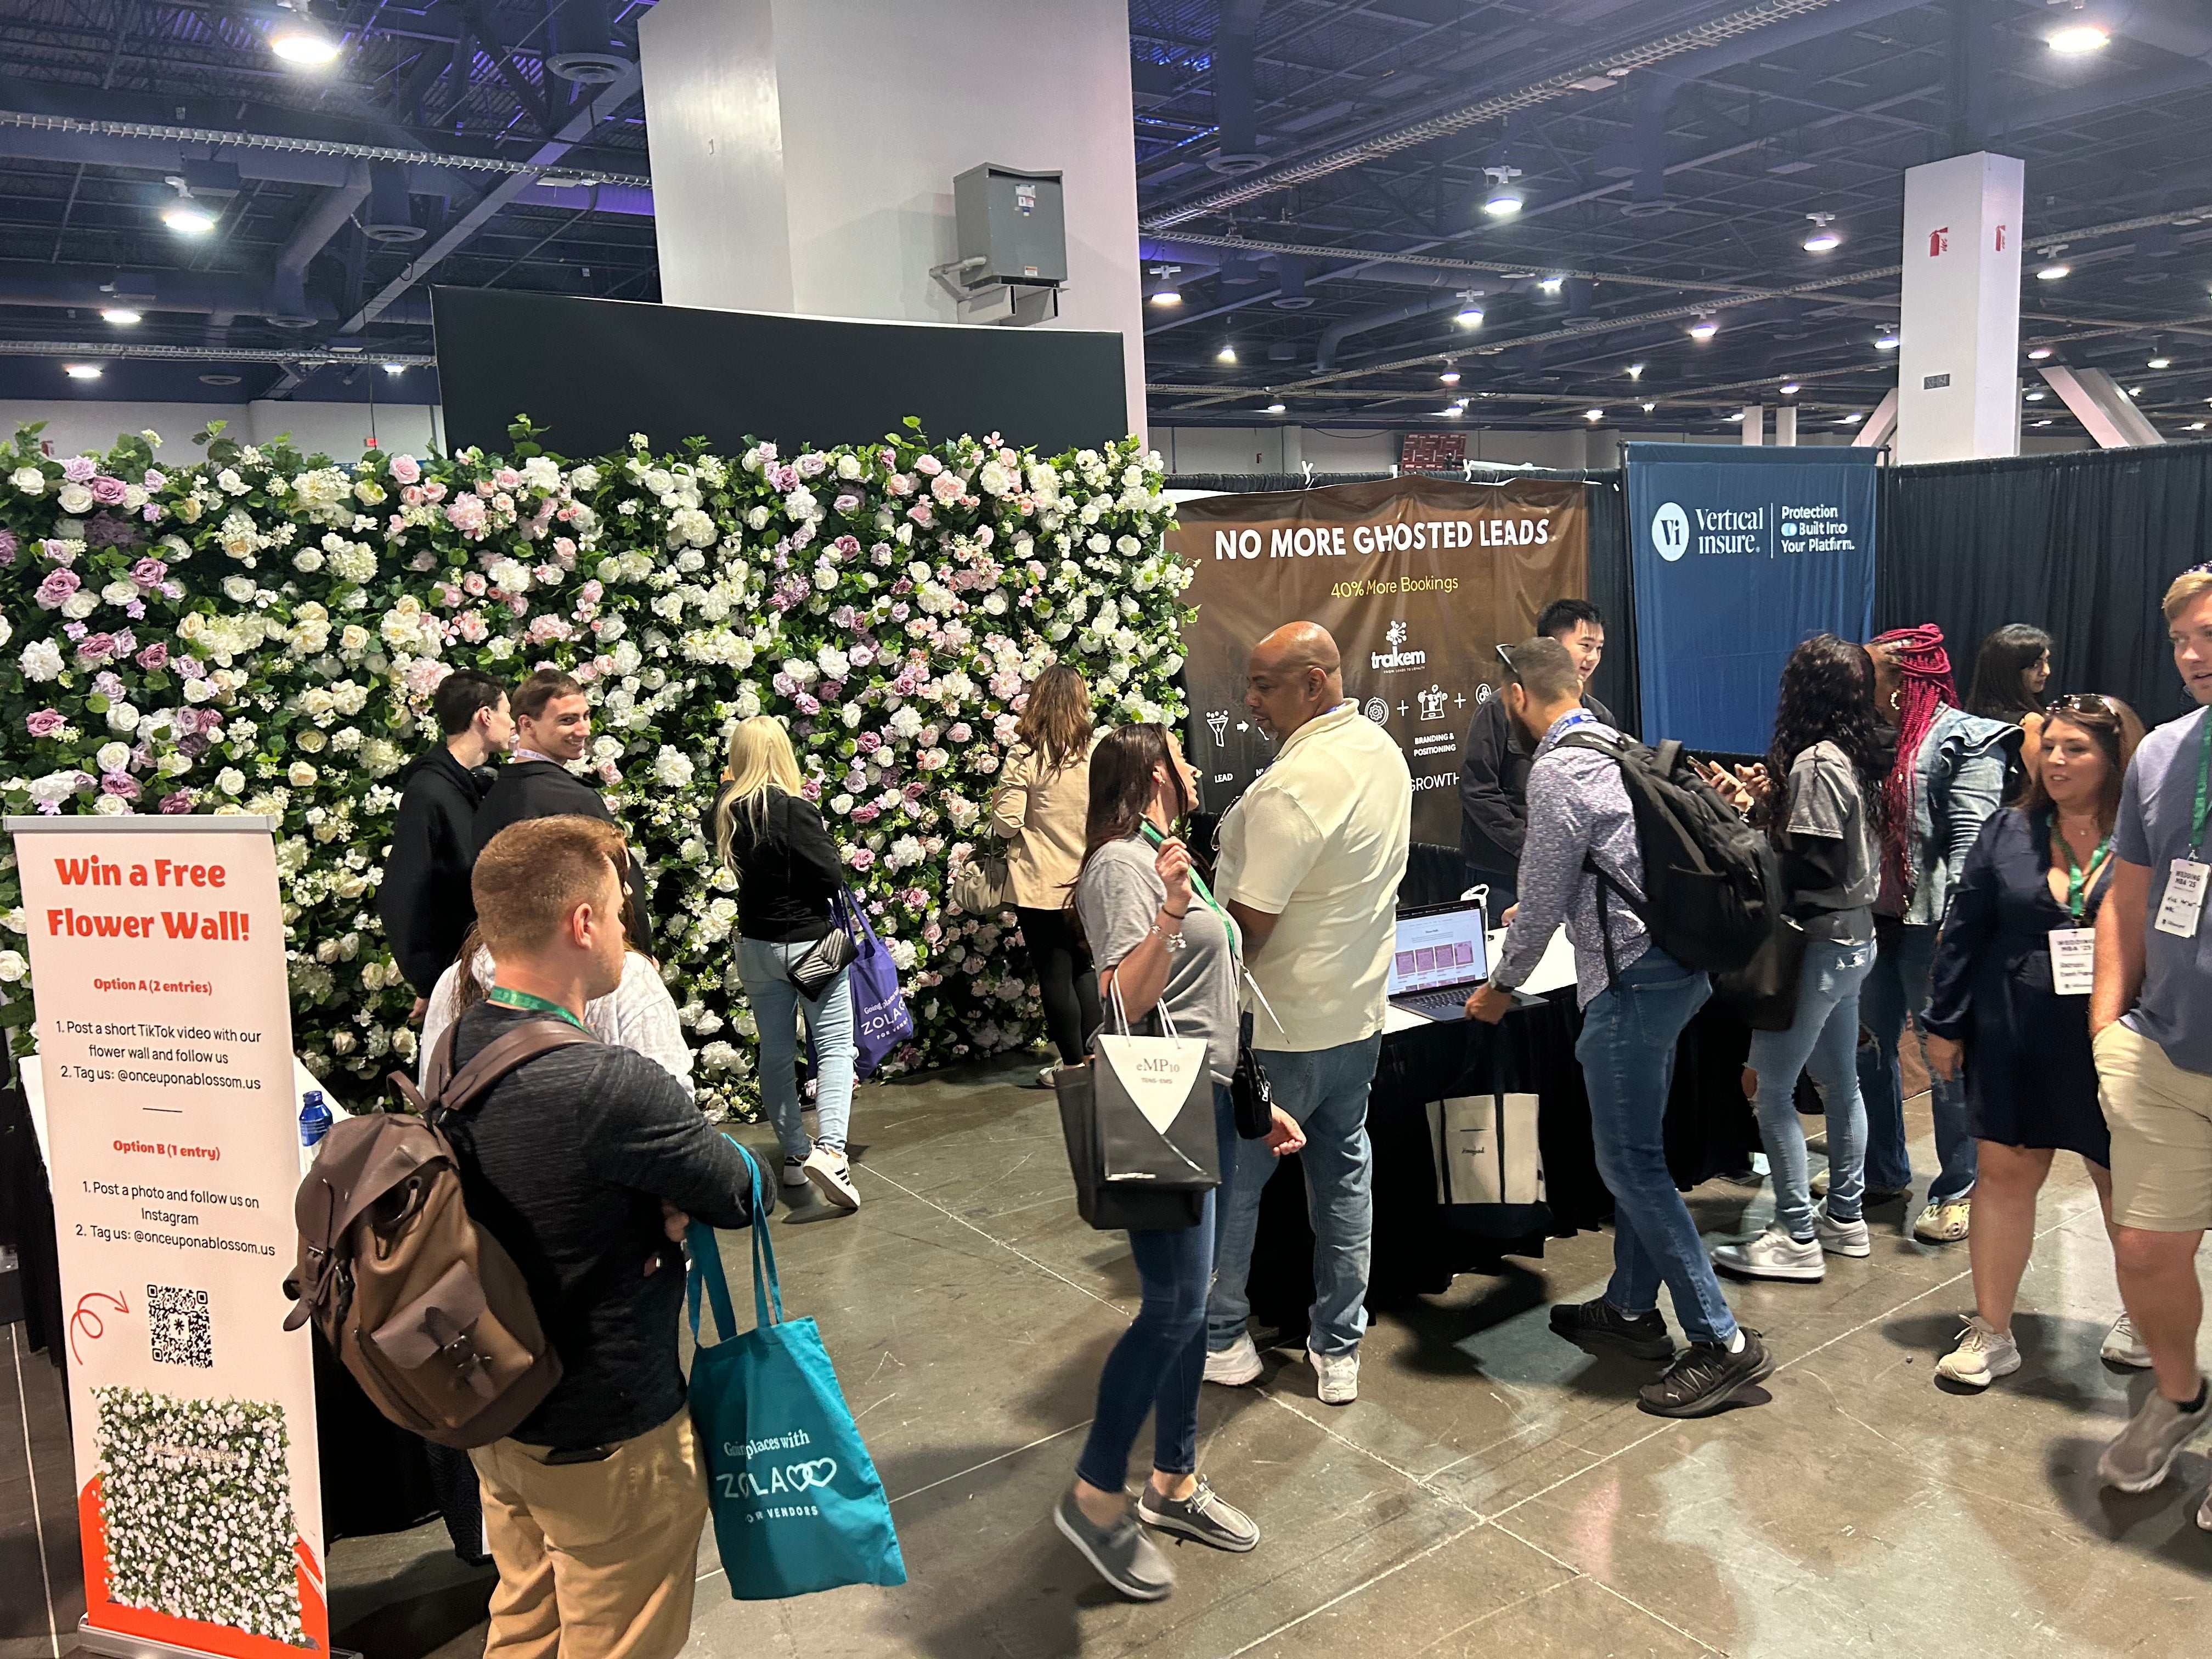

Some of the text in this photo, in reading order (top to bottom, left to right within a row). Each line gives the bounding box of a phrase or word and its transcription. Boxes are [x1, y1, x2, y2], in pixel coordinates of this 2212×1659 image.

[1695, 507, 1763, 531] Vertical
[1781, 504, 1838, 520] Protection
[1215, 518, 1550, 561] NO MORE GHOSTED LEADS
[1660, 520, 1681, 545] Vi
[1798, 521, 1826, 536] Built
[1781, 540, 1805, 554] Your
[1330, 575, 1459, 599] 40% More Bookings
[1371, 646, 1425, 669] trakem
[1413, 743, 1457, 757] POSITIONING
[1414, 733, 1448, 745] BRANDING
[1214, 773, 1233, 783] LEAD
[54, 855, 226, 887] Win a Free
[47, 908, 250, 941] Flower Wall!
[94, 978, 213, 996] Option A (2 entries)
[56, 1020, 262, 1043] 1. Post a short TikTok video with our
[861, 1008, 902, 1036] ZOLA
[876, 1030, 890, 1040] FOR
[88, 1044, 229, 1064] flower wall and follow us
[60, 1065, 261, 1090] 2. Tag us: @onceuponablossom.us
[113, 1139, 221, 1161] Option B (1 entry)
[82, 1180, 259, 1209] 1. Post a photo and follow us on
[141, 1207, 199, 1227] Instagram
[75, 1223, 275, 1256] 2. Tag us: @onceuponablossom.us
[746, 1438, 780, 1460] places
[780, 1429, 811, 1448] with
[766, 1505, 819, 1519] VENDORS
